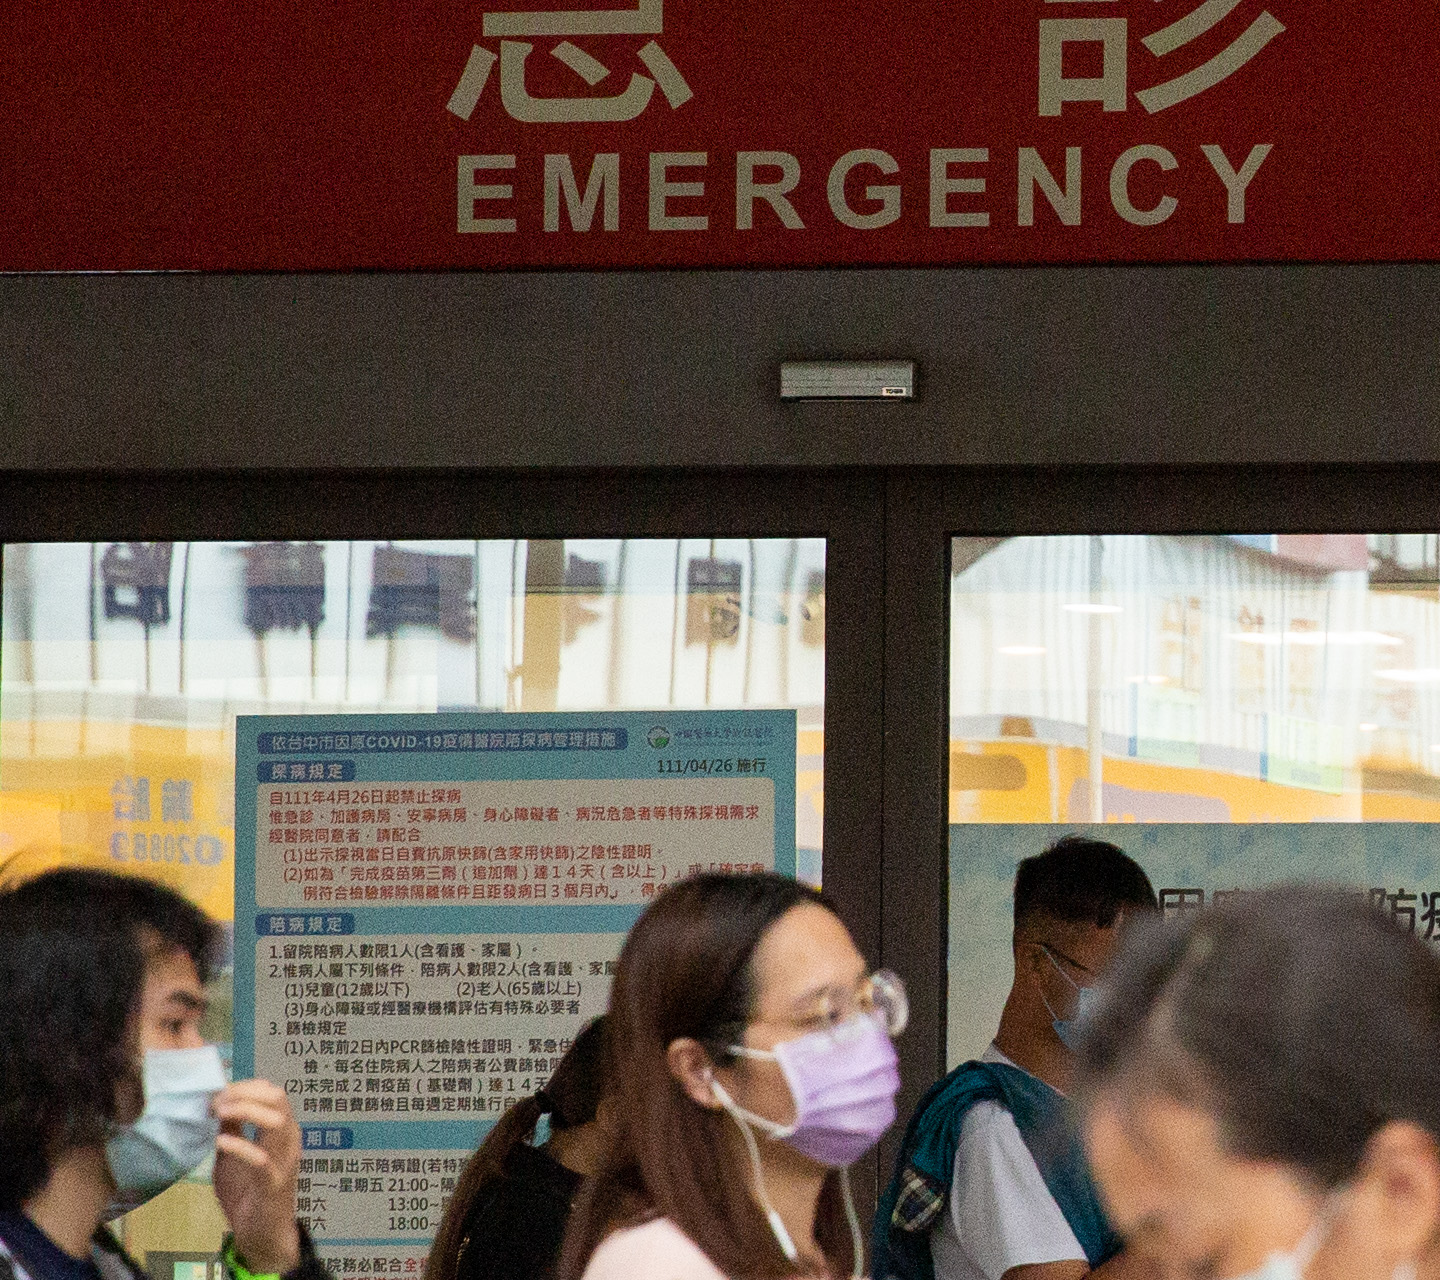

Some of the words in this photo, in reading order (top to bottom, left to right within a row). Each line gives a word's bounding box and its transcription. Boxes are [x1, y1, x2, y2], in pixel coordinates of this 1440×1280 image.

[456, 143, 1275, 235] EMERGENCY
[272, 764, 343, 779] 探病規定
[657, 759, 732, 774] 111/04/26
[737, 757, 766, 773] 施行
[269, 788, 461, 805] 自111年4月26日起禁止探病
[269, 916, 342, 933] 陪病規定
